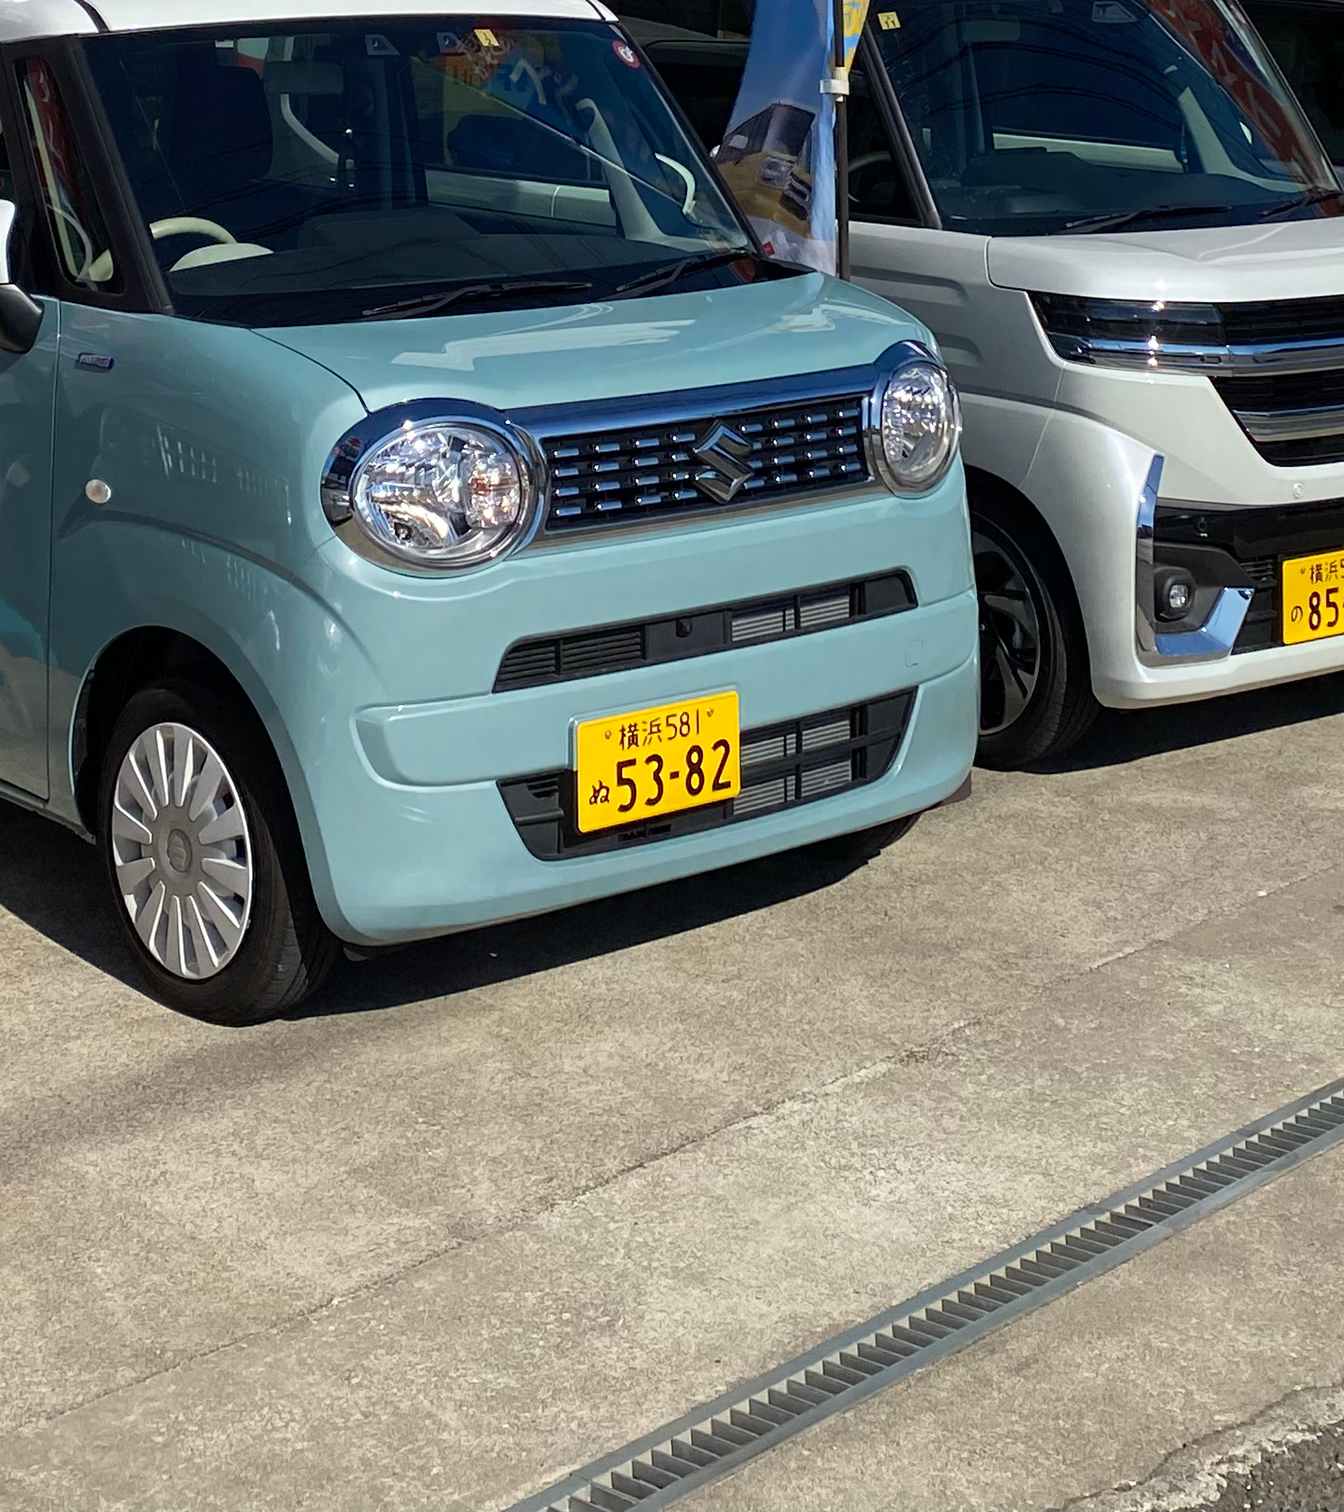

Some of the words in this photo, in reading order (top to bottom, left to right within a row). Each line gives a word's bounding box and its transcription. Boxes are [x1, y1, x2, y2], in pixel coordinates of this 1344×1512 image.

[1290, 605, 1304, 624] の
[589, 779, 610, 805] ぬ
[616, 739, 732, 813] 53-82
